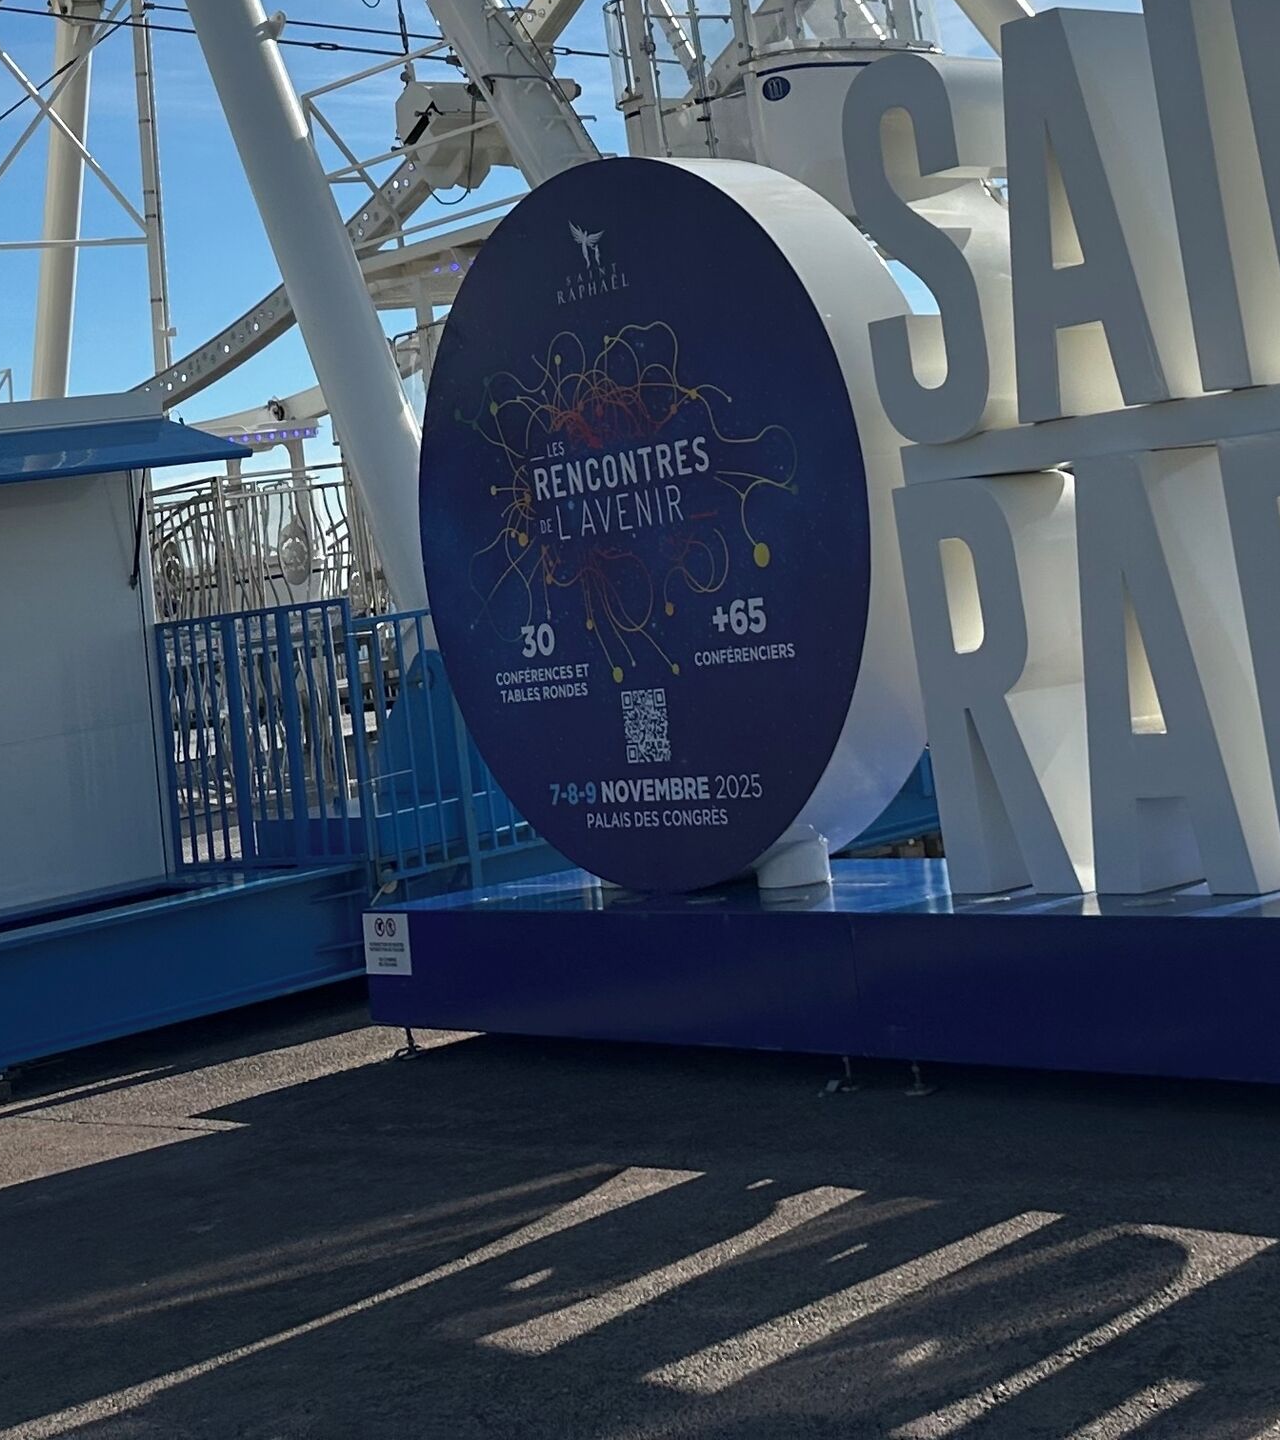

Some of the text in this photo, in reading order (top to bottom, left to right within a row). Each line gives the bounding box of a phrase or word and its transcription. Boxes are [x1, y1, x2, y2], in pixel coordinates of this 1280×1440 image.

[767, 77, 783, 100] 11
[565, 262, 617, 287] SAINT
[546, 441, 565, 458] LES
[533, 436, 710, 501] RENCONTRES
[539, 518, 553, 535] DE
[712, 597, 767, 635] +65
[520, 623, 556, 658] 30
[694, 643, 796, 667] CONFÉRENCIERS
[495, 663, 590, 686] CONFÉRENCES ET
[500, 682, 589, 704] TABLES RONDES
[549, 773, 763, 806] 7-8-9 NOVEMBRE 2025
[586, 805, 729, 829] PALAIS DES CONGRÈS
